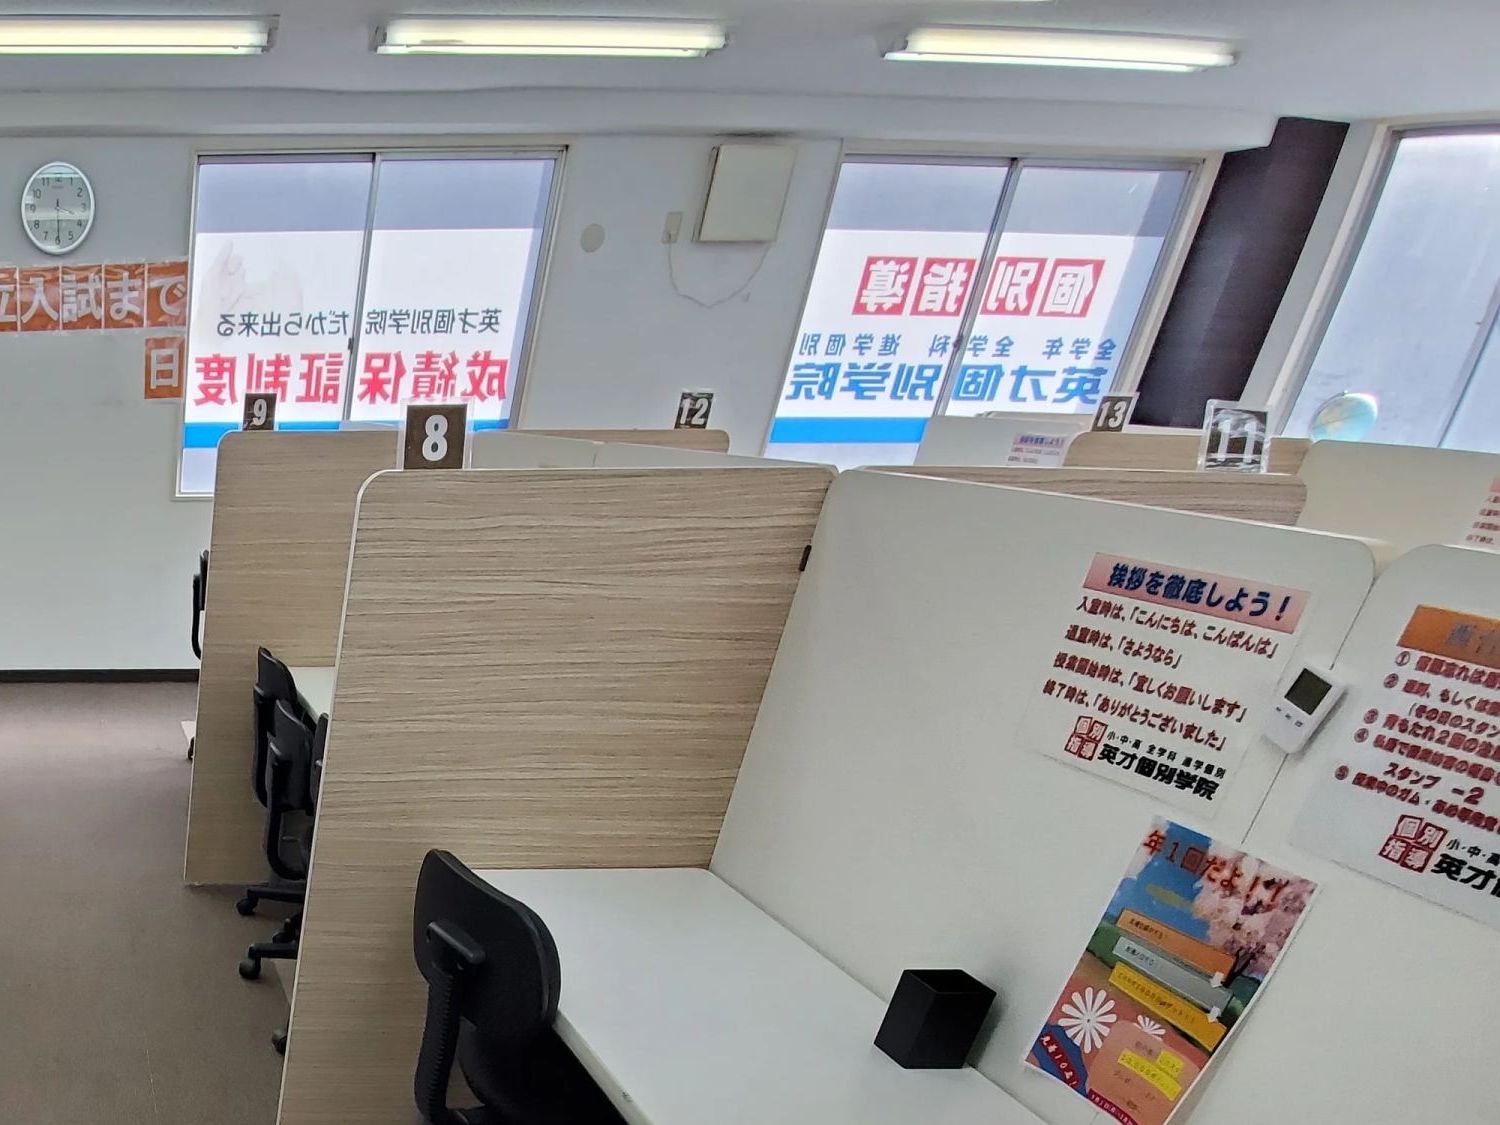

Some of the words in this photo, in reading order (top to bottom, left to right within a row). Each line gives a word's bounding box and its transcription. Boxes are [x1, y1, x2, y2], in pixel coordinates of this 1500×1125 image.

[150, 348, 180, 389] 日
[252, 399, 267, 426] 9
[679, 399, 710, 426] 12
[1096, 400, 1126, 428] 13
[422, 414, 448, 461] 8
[1097, 742, 1221, 802] 英才個別学院
[1430, 852, 1500, 898] 英才
